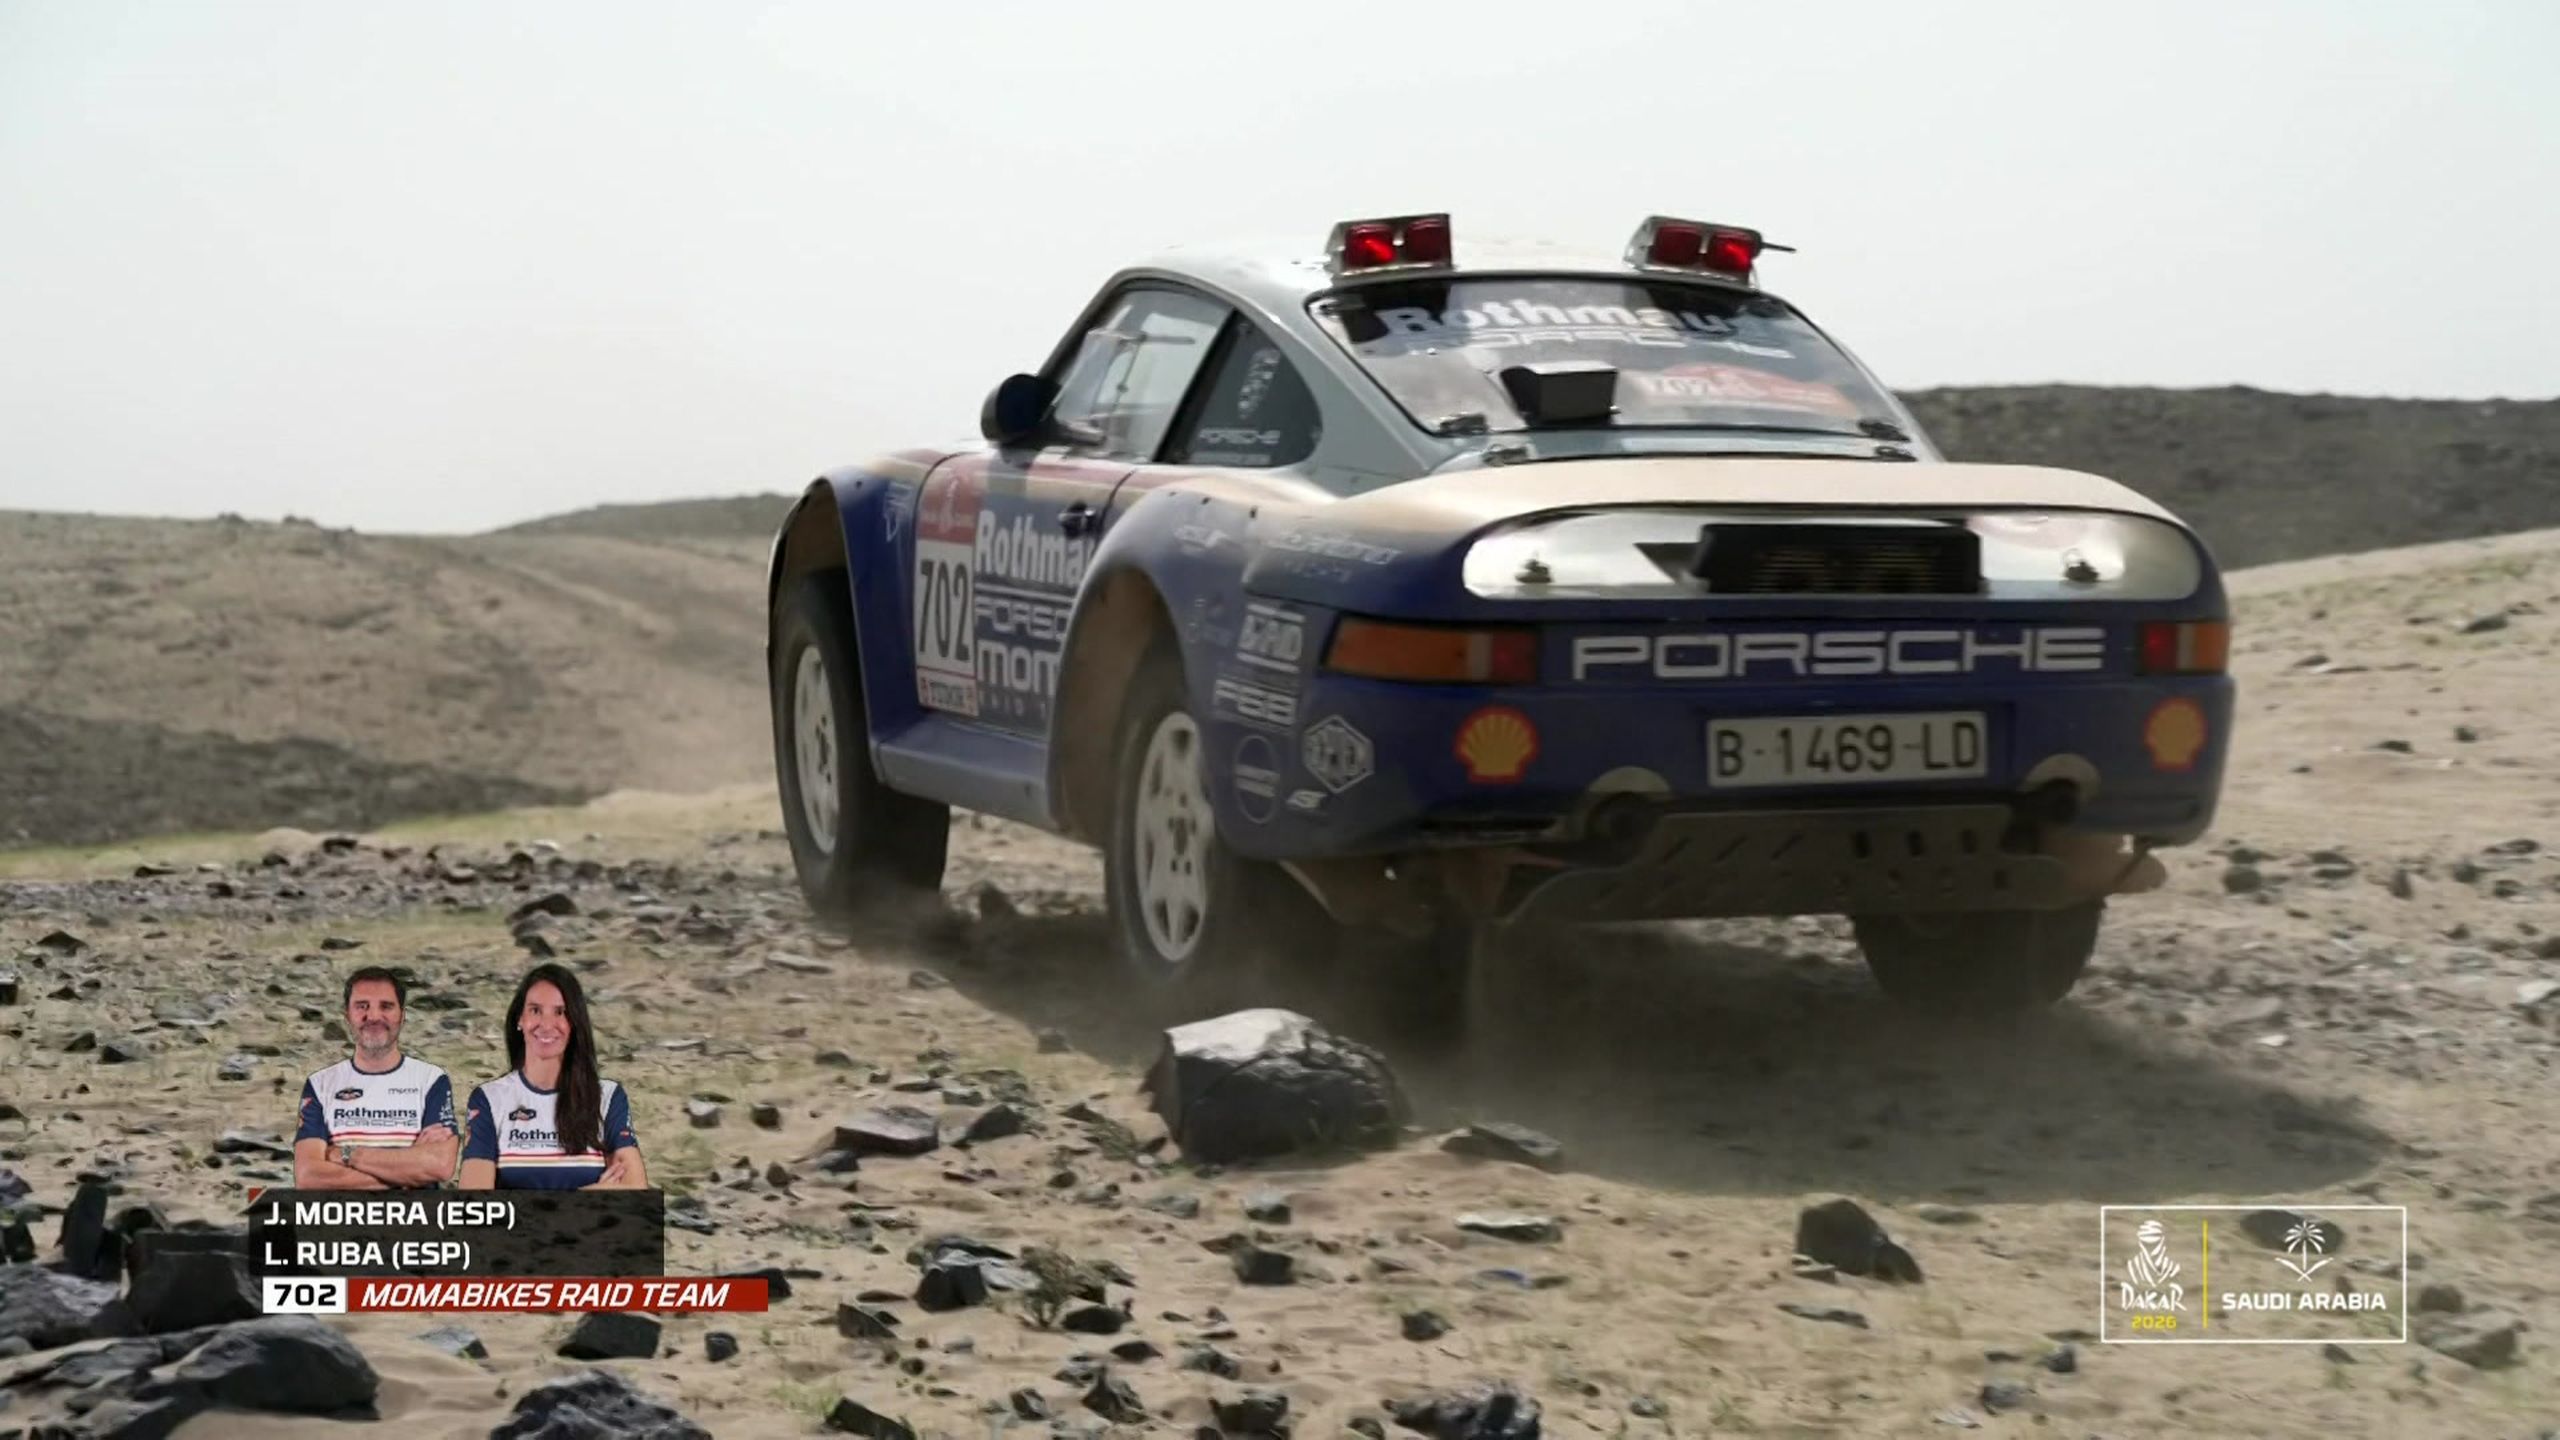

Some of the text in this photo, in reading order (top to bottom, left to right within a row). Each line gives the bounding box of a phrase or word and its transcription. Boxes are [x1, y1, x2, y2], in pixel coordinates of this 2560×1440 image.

[917, 557, 971, 662] 702
[1571, 627, 2106, 680] PORSCHE
[1716, 721, 1979, 777] B-1469-LD
[333, 1106, 418, 1120] Rothmans
